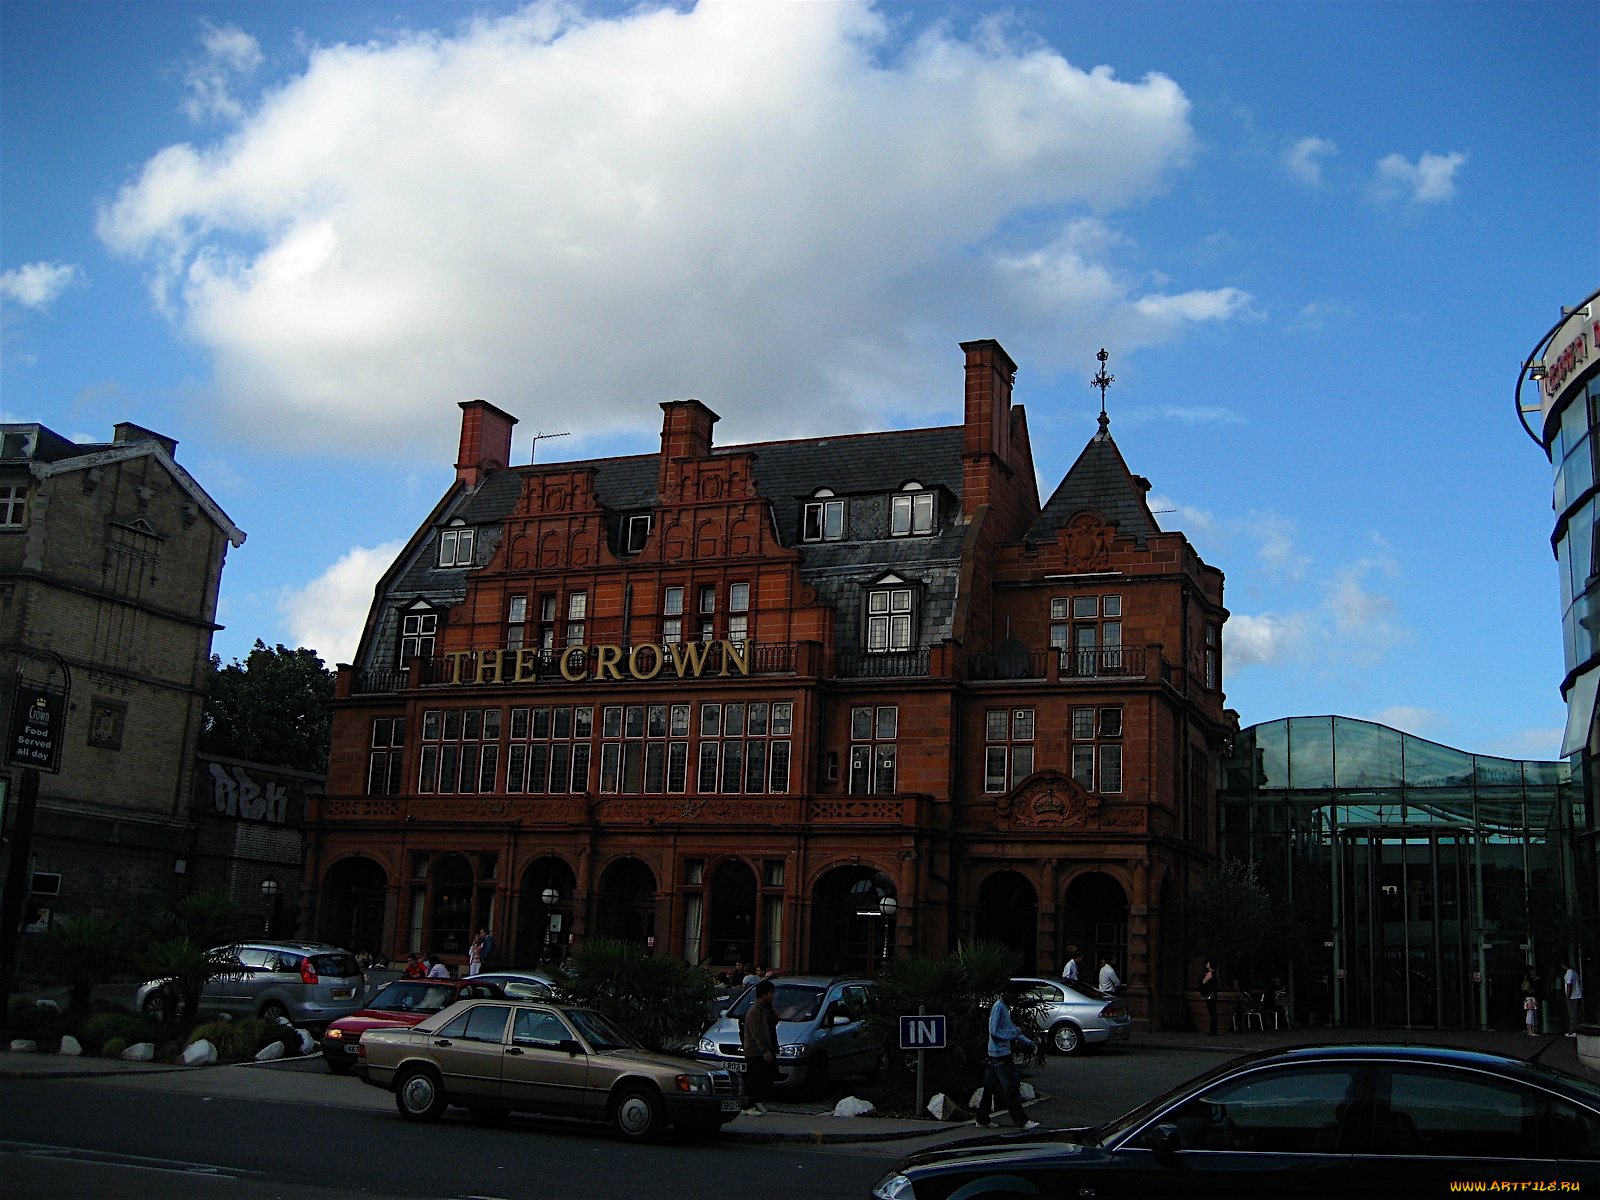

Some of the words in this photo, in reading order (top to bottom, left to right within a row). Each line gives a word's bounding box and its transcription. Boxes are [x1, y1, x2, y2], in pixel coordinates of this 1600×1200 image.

[446, 647, 537, 686] THE
[560, 638, 752, 681] CROWN
[24, 725, 49, 738] Food
[17, 735, 52, 749] Served
[16, 747, 29, 756] all
[31, 749, 49, 761] day
[907, 1020, 937, 1044] IN
